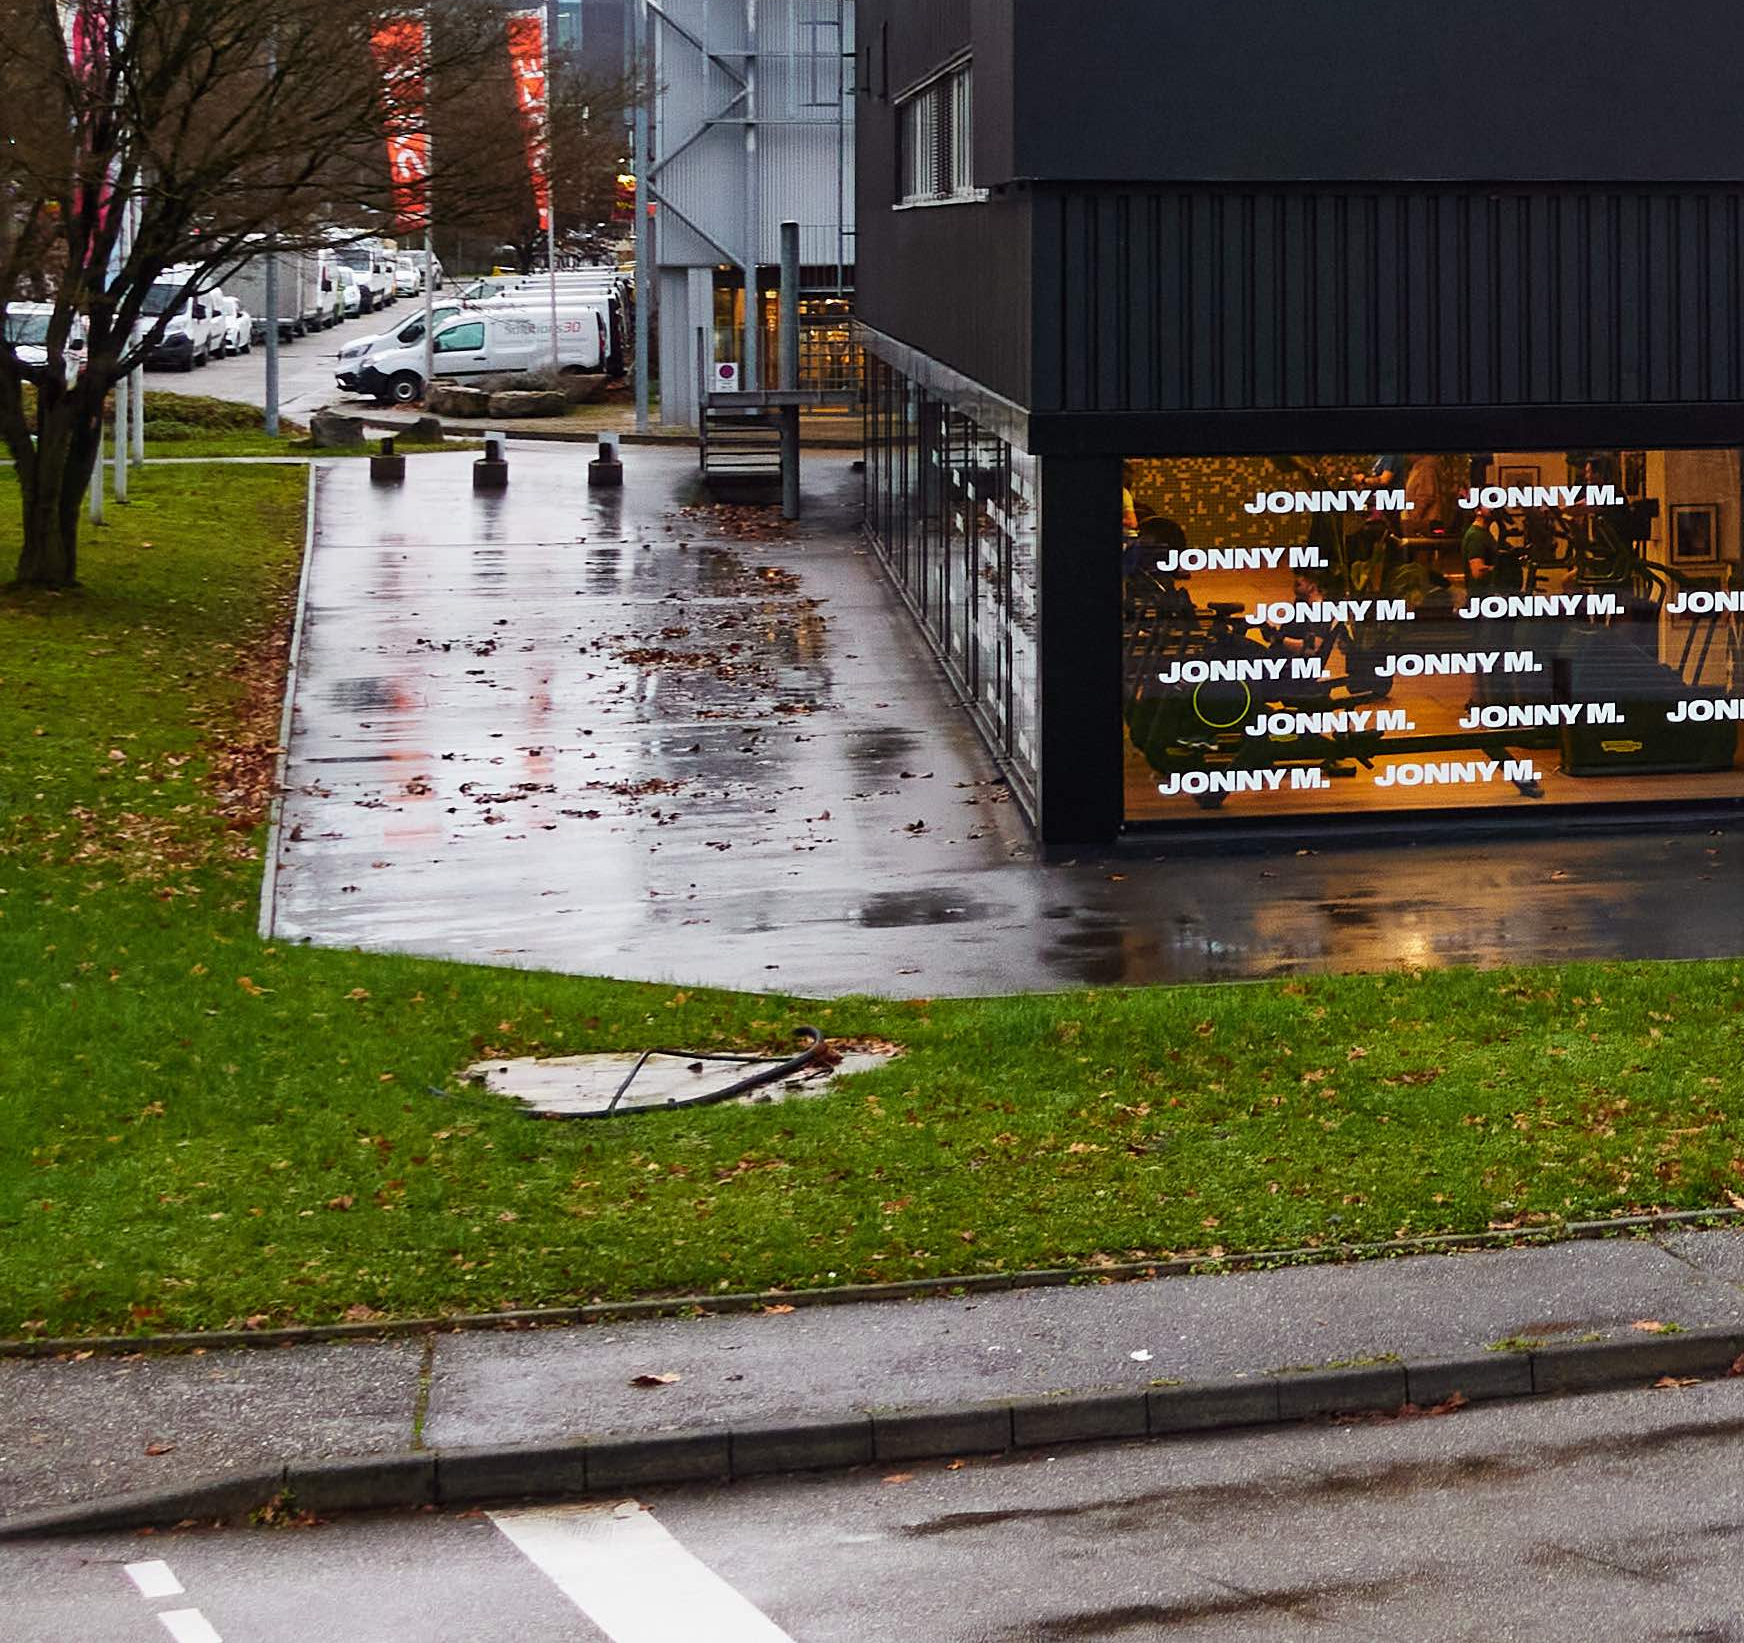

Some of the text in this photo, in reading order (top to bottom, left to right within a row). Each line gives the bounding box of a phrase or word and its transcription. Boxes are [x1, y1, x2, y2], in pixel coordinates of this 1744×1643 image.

[1244, 489, 1415, 514] JONNY M.
[1458, 484, 1624, 509] JONNY M.
[1156, 546, 1329, 572] JONNY M.
[1244, 599, 1415, 625] JONNY M.
[1458, 593, 1625, 619] JONNY M.
[1158, 657, 1331, 684] JONNY M.
[1374, 650, 1543, 677] JONNY M.
[1245, 709, 1416, 736] JONNY M.
[1458, 702, 1625, 729] JONNY M.
[1158, 767, 1331, 795] JONNY M.
[1374, 759, 1542, 787] JONNY M.
